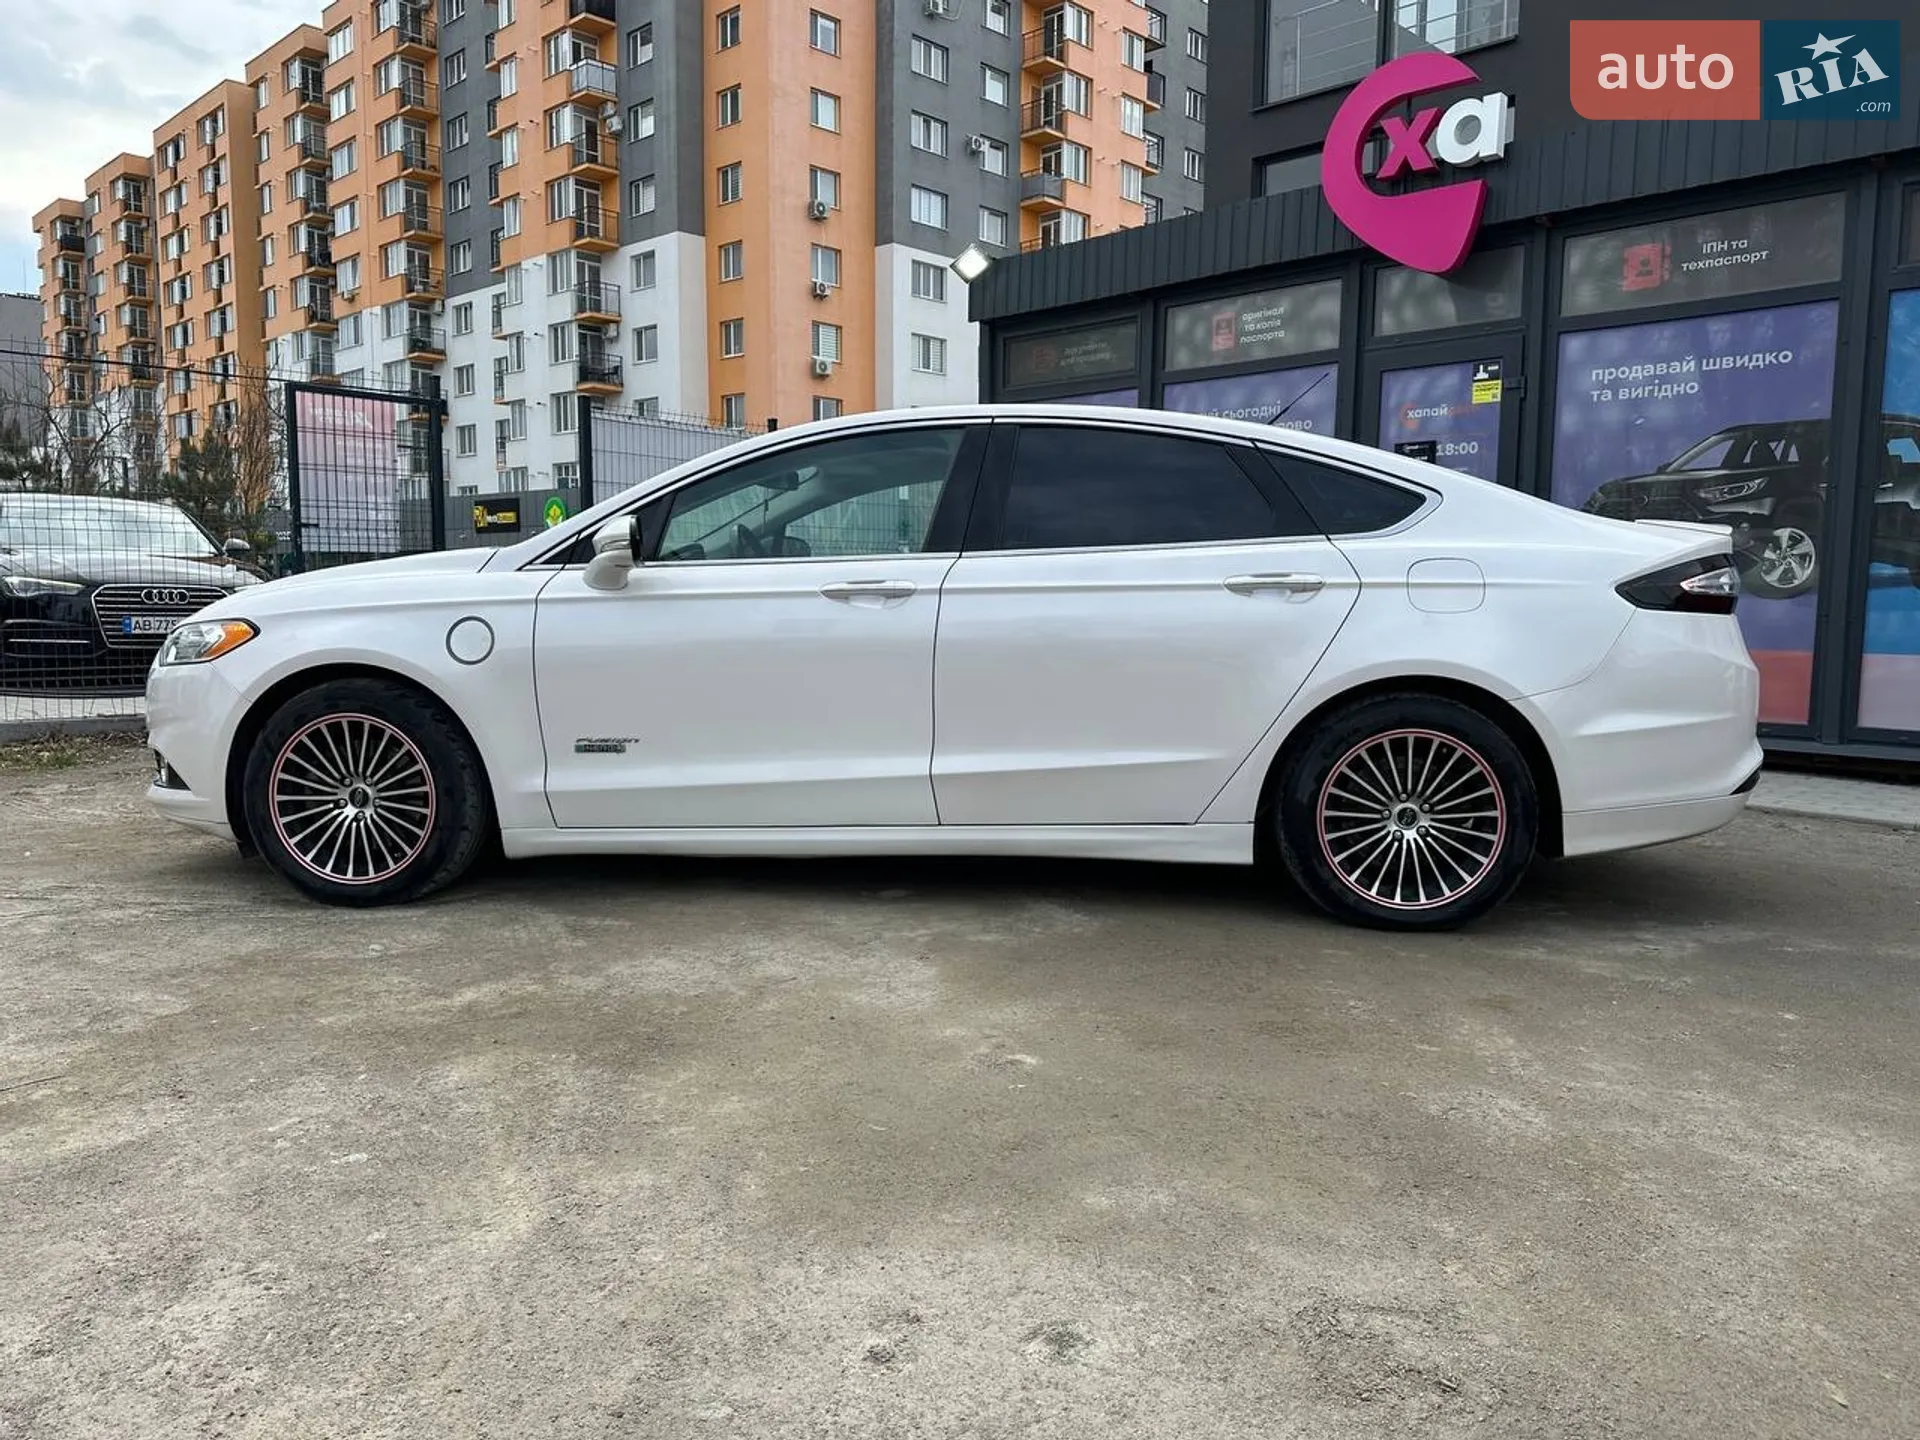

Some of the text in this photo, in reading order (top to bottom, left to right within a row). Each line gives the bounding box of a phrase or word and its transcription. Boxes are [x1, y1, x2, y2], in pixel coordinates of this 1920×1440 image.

[1730, 239, 1749, 250] та
[1681, 250, 1769, 271] техпаспорт
[1242, 306, 1284, 322] оригінал
[1240, 330, 1285, 343] паспорта
[1591, 350, 1793, 384] продавай швидко
[1590, 379, 1699, 402] та вигідно
[1406, 403, 1448, 419] хапай
[1436, 442, 1479, 457] 18:00
